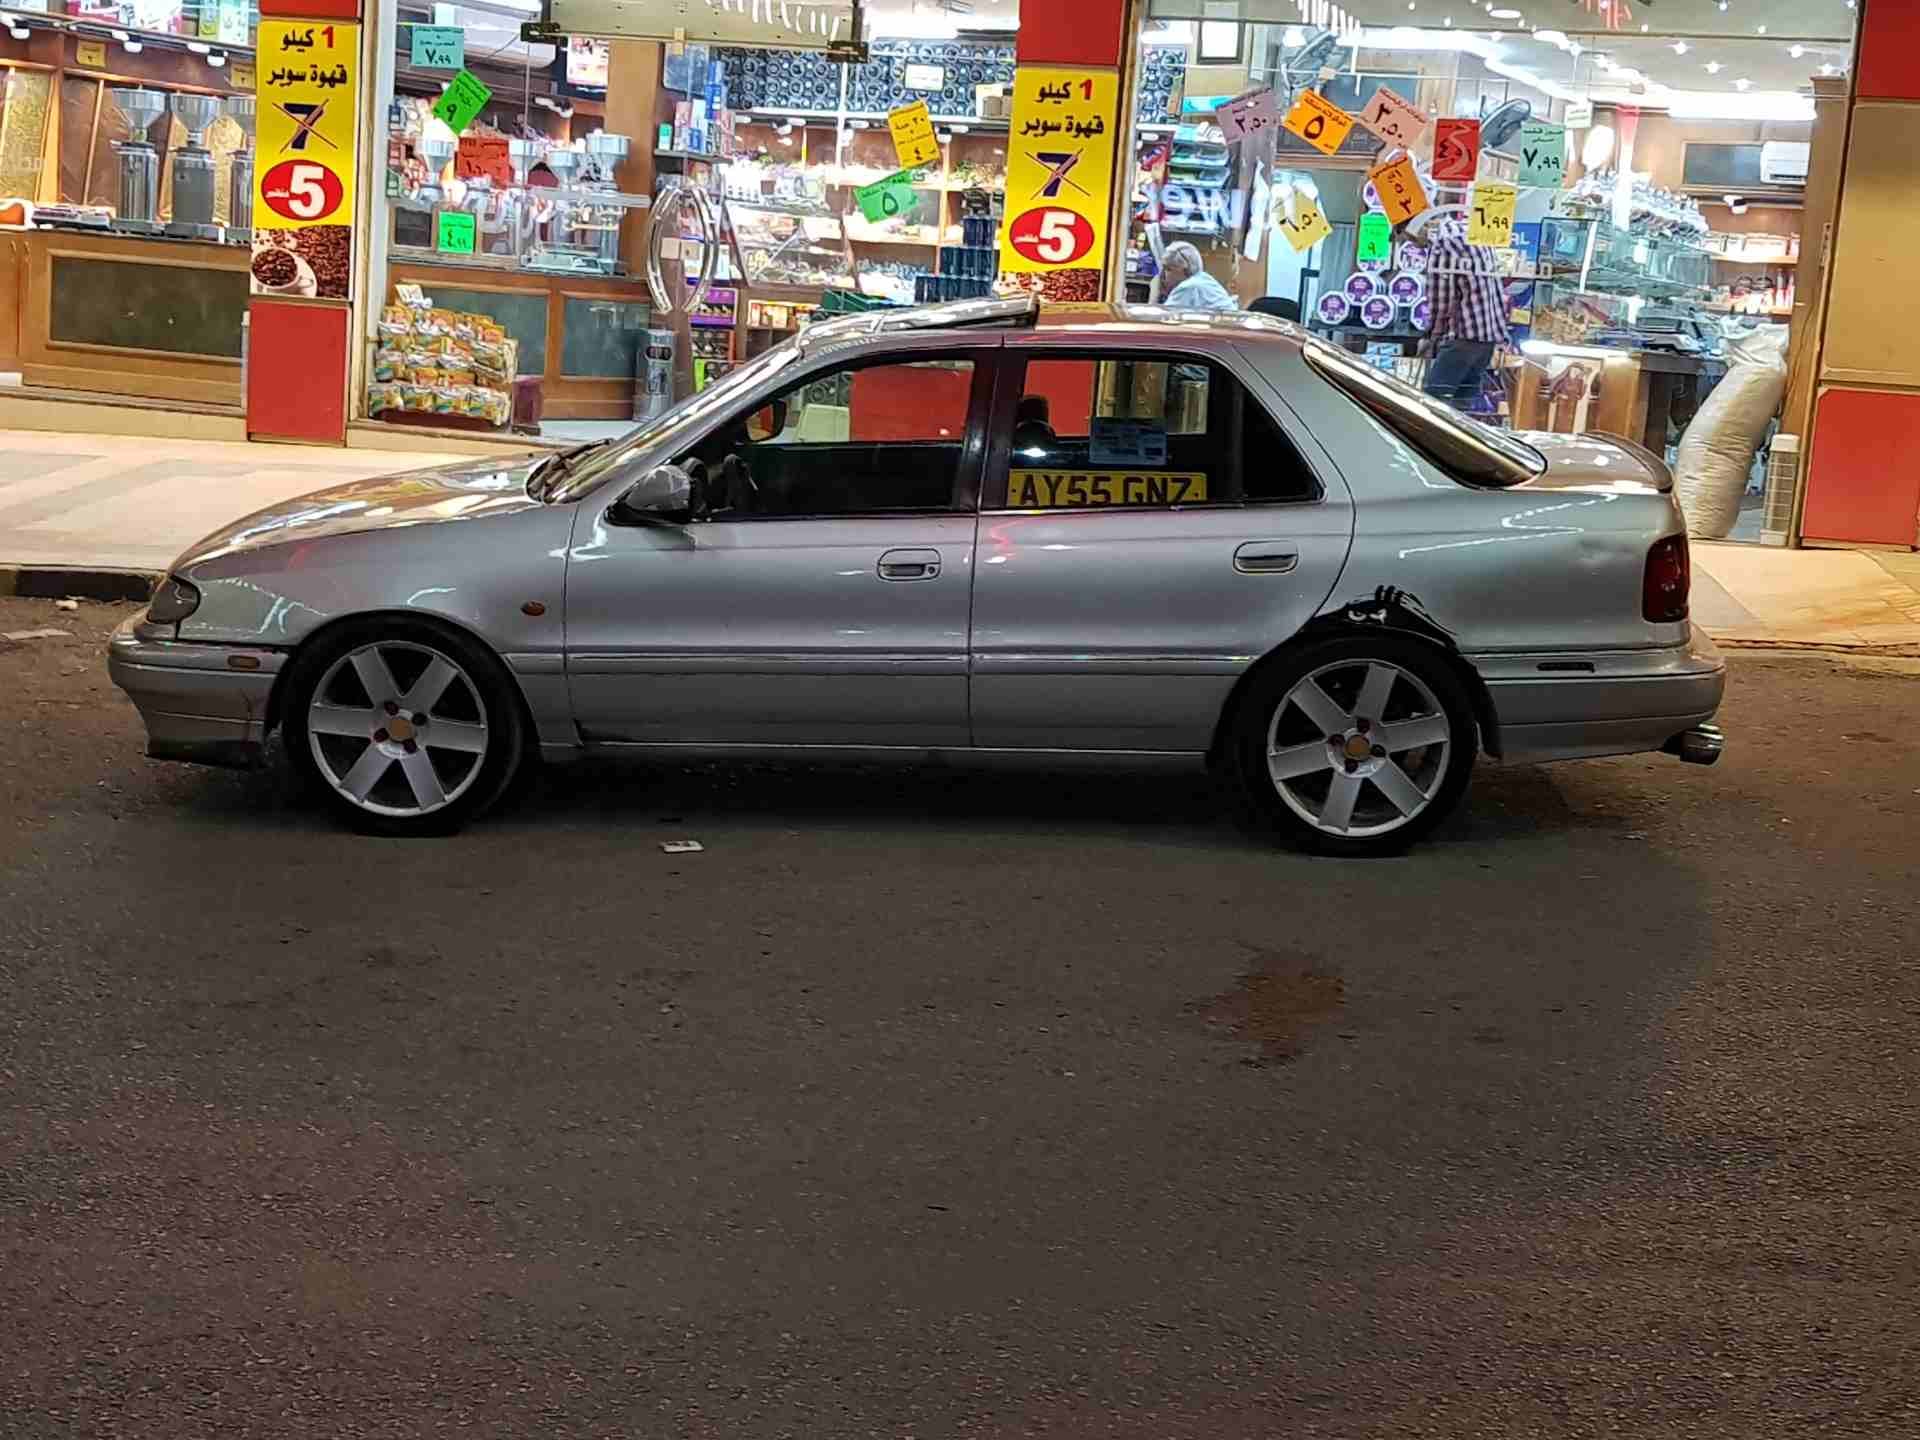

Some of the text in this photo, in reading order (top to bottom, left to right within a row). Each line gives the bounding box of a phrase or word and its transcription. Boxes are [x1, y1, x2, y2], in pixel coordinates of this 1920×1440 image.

[279, 25, 334, 52] 1 كيلو
[309, 64, 347, 88] قهوة
[1033, 79, 1093, 104] 1 كيلو
[283, 102, 324, 150] 7
[1064, 114, 1104, 138] قهوة
[1036, 152, 1079, 197] 7
[288, 165, 326, 218] 5
[1036, 211, 1076, 262] 5
[1020, 474, 1111, 505] AY55
